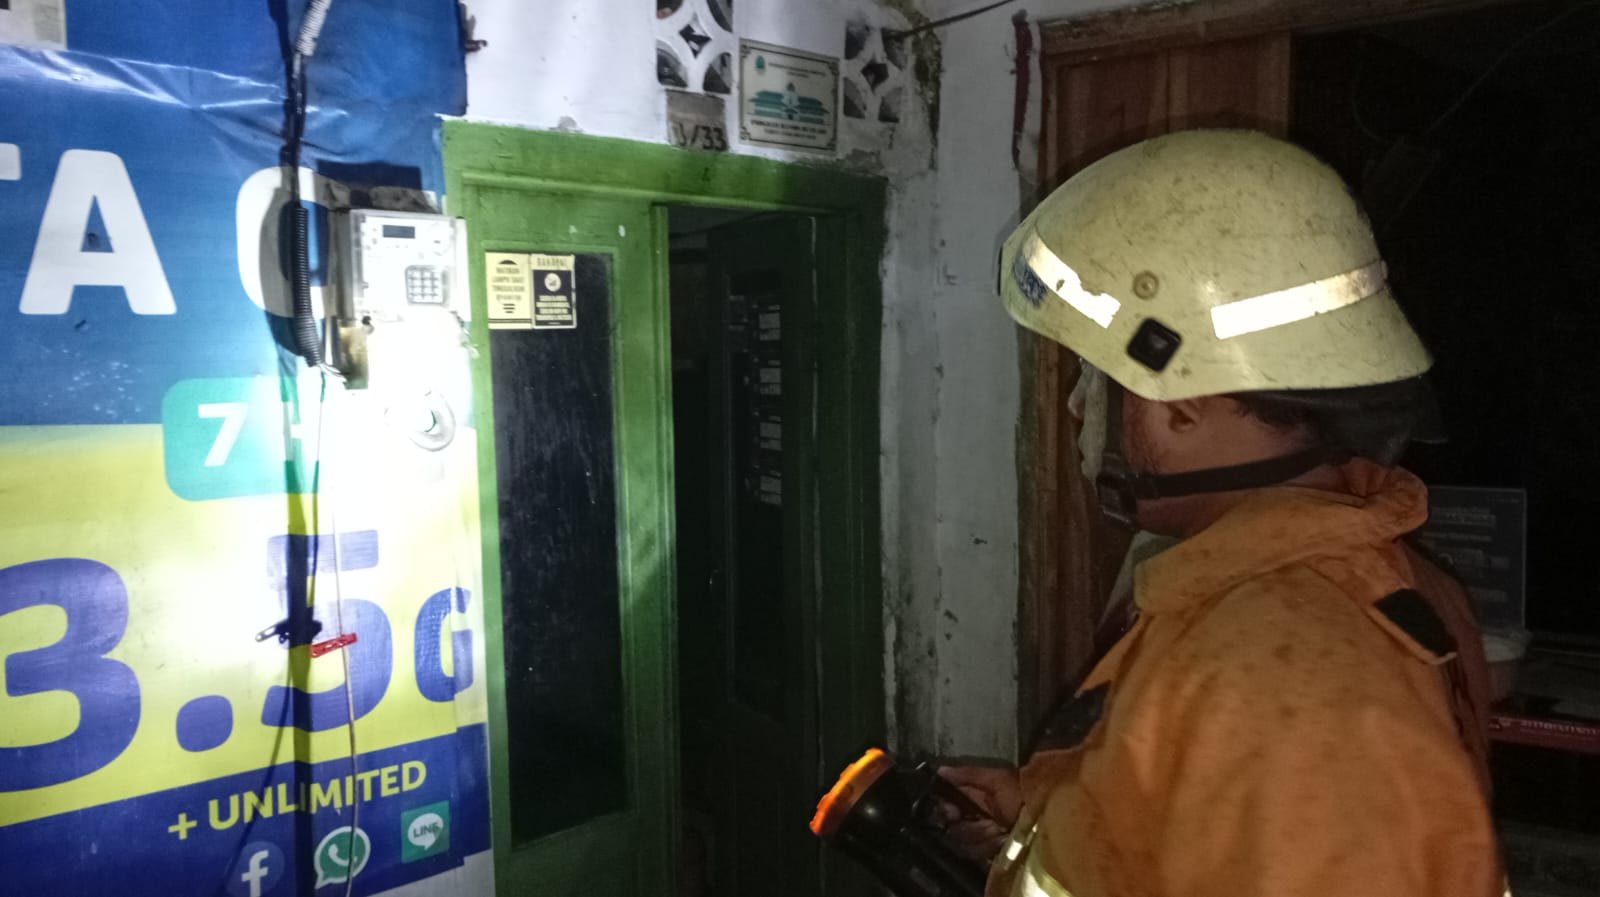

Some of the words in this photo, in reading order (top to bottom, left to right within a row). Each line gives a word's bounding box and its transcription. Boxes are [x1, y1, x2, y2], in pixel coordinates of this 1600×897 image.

[0, 144, 177, 315] A
[208, 760, 427, 830] UNLIMITED
[413, 822, 441, 839] LINE
